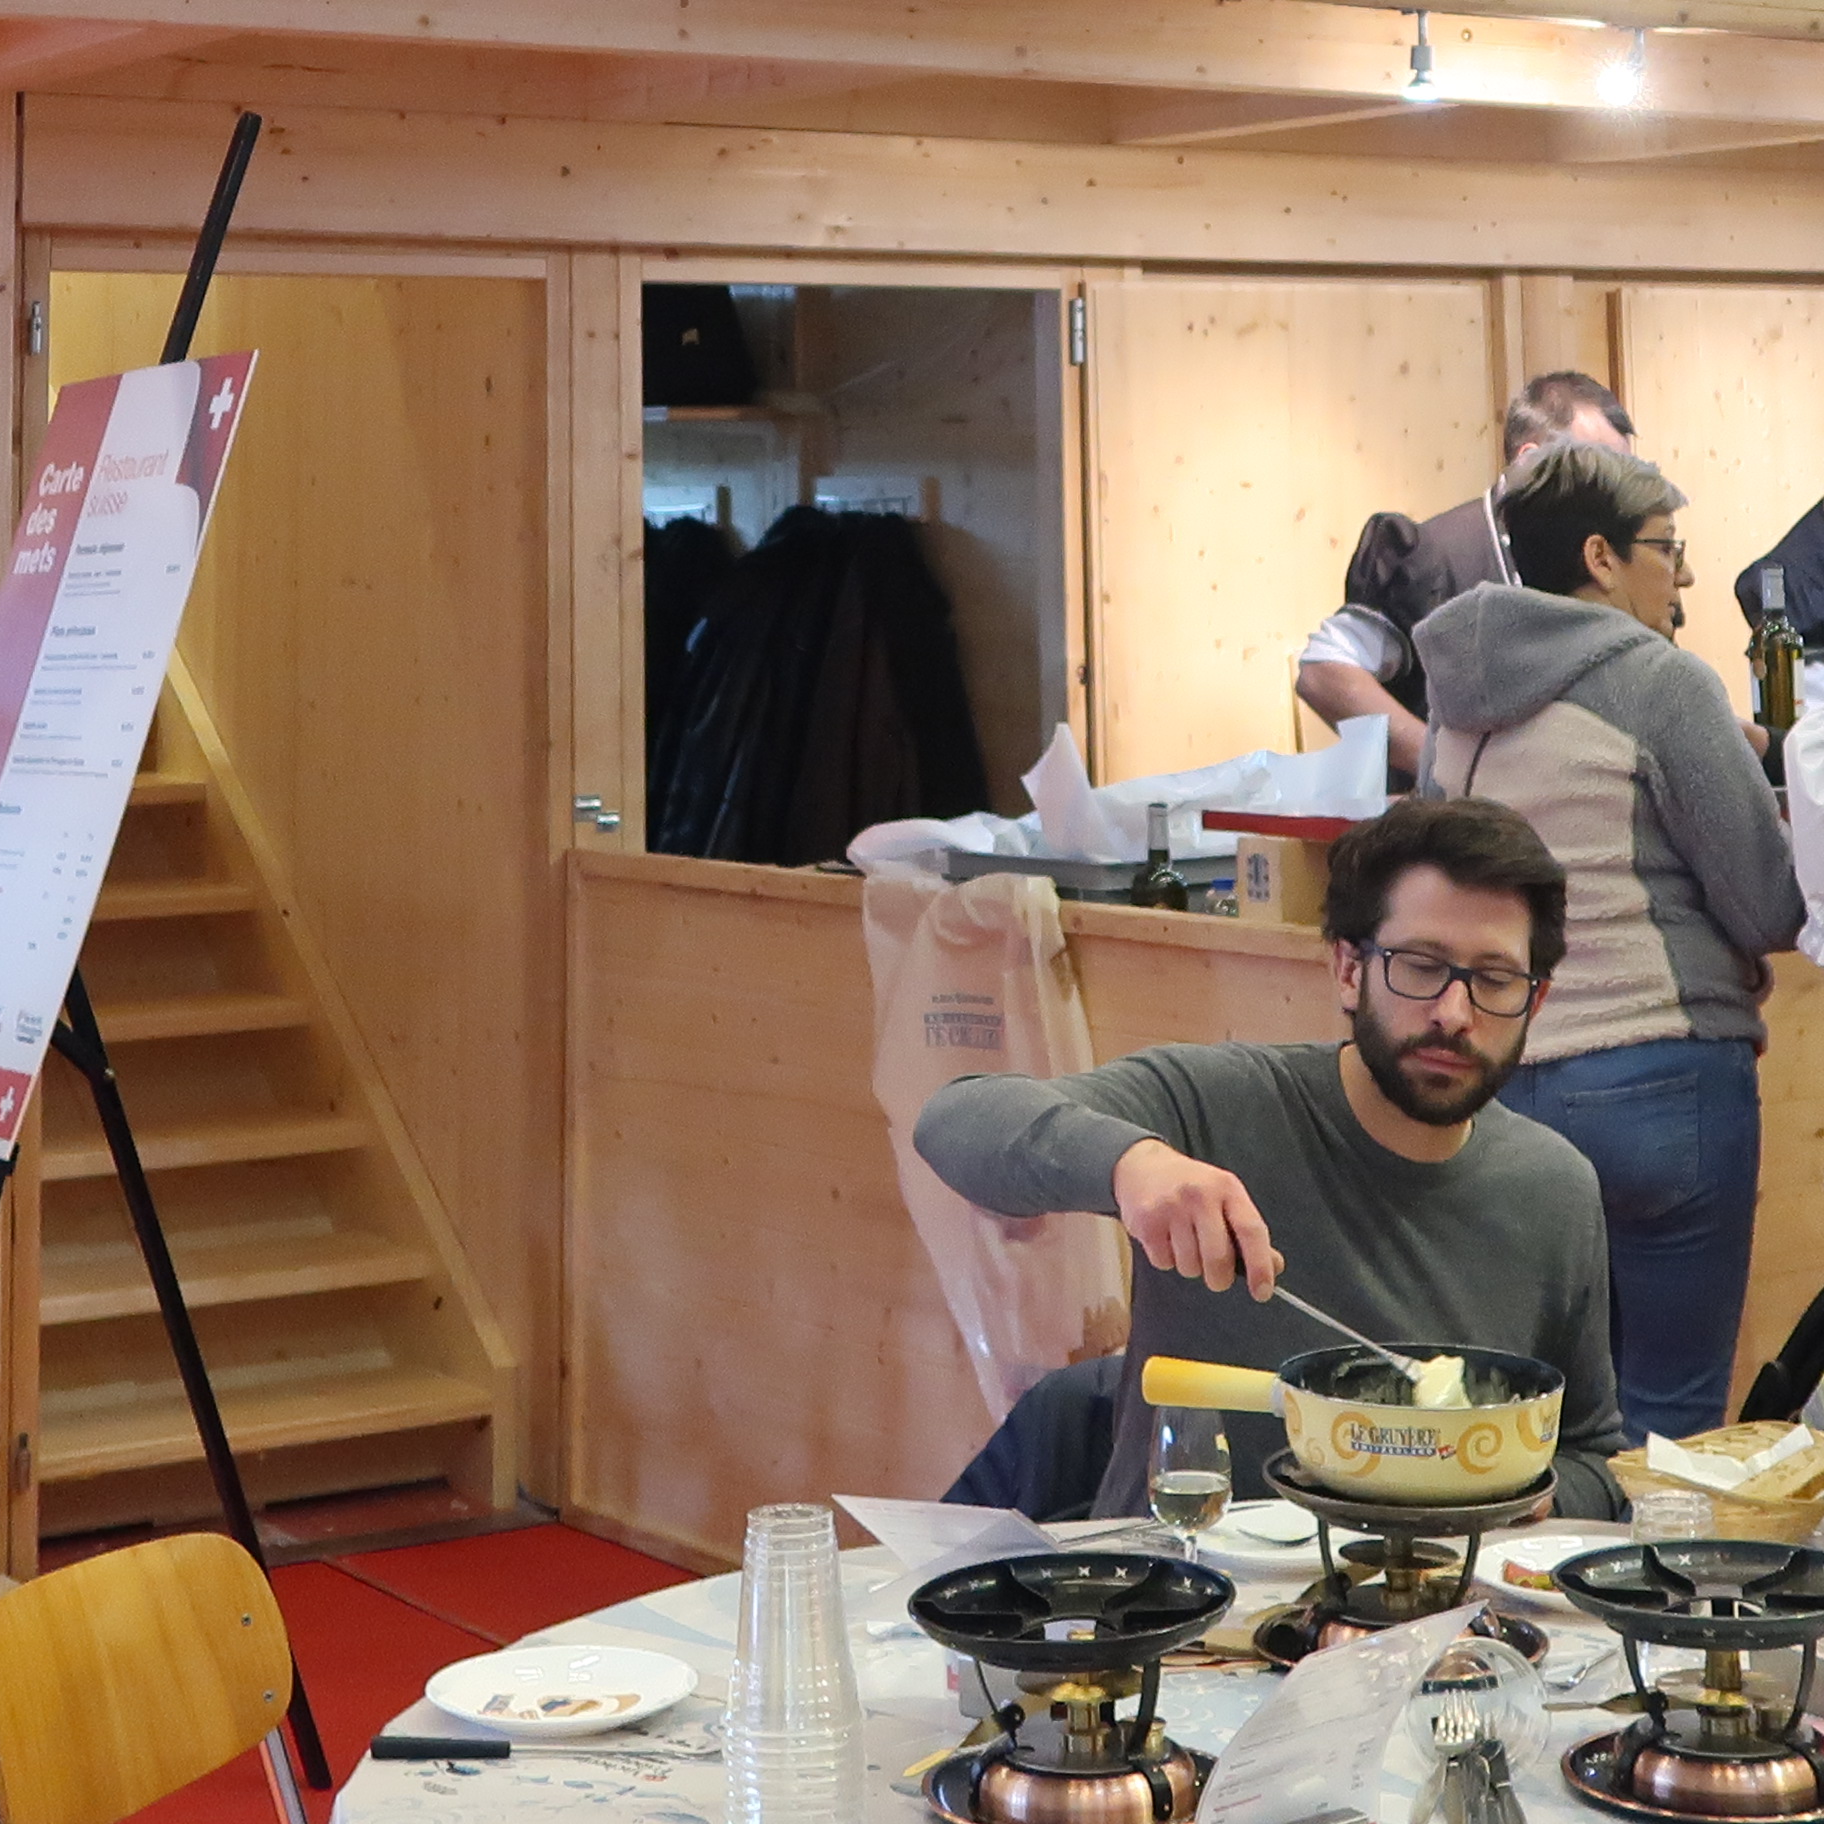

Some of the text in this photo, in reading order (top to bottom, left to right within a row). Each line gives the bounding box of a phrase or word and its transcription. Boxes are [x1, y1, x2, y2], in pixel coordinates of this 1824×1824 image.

[38, 460, 85, 497] Carte
[25, 502, 58, 537] des
[12, 540, 57, 575] mets
